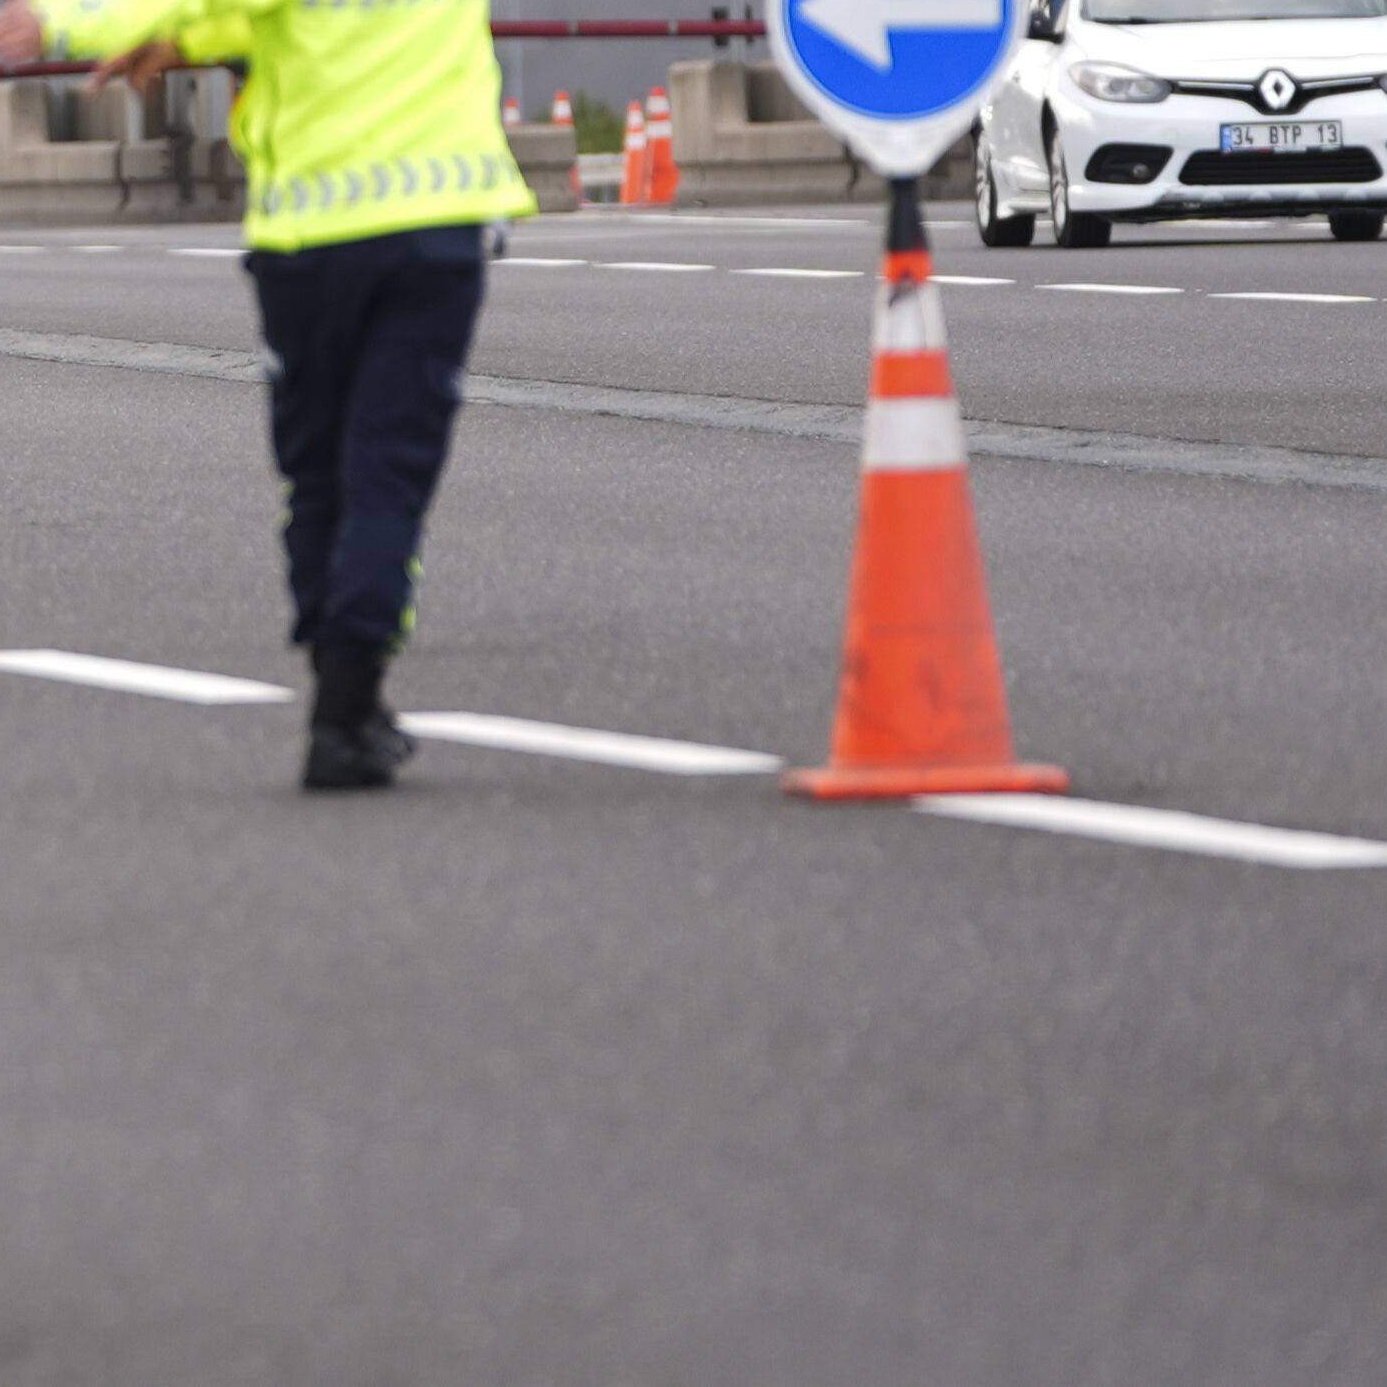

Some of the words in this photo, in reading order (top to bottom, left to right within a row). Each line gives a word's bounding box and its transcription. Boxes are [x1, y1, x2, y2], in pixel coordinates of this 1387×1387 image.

[1233, 127, 1254, 145] 34
[1269, 125, 1302, 144] BTP
[1317, 124, 1338, 143] 13
